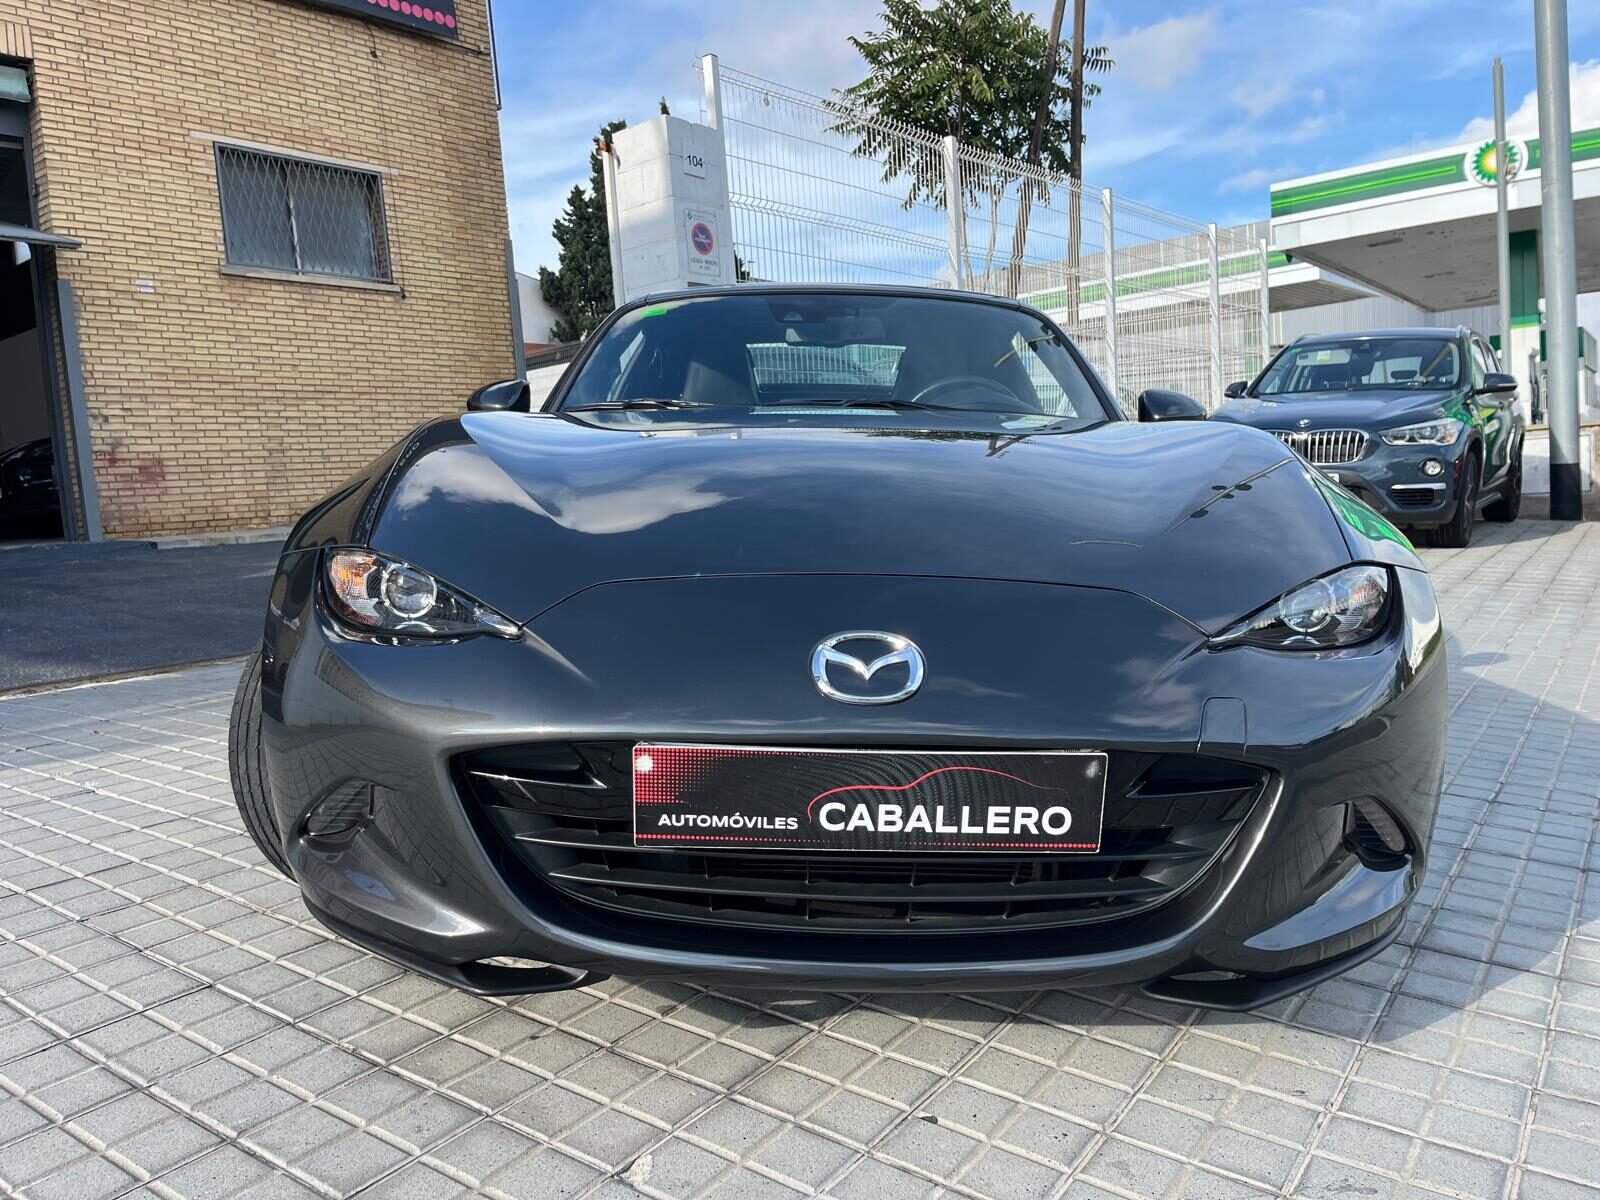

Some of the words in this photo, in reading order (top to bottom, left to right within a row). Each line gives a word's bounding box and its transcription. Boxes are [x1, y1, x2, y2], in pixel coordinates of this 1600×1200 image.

[688, 155, 703, 168] 104
[658, 812, 798, 830] AUTOMÓVILES
[819, 803, 1072, 836] CABALLERO
